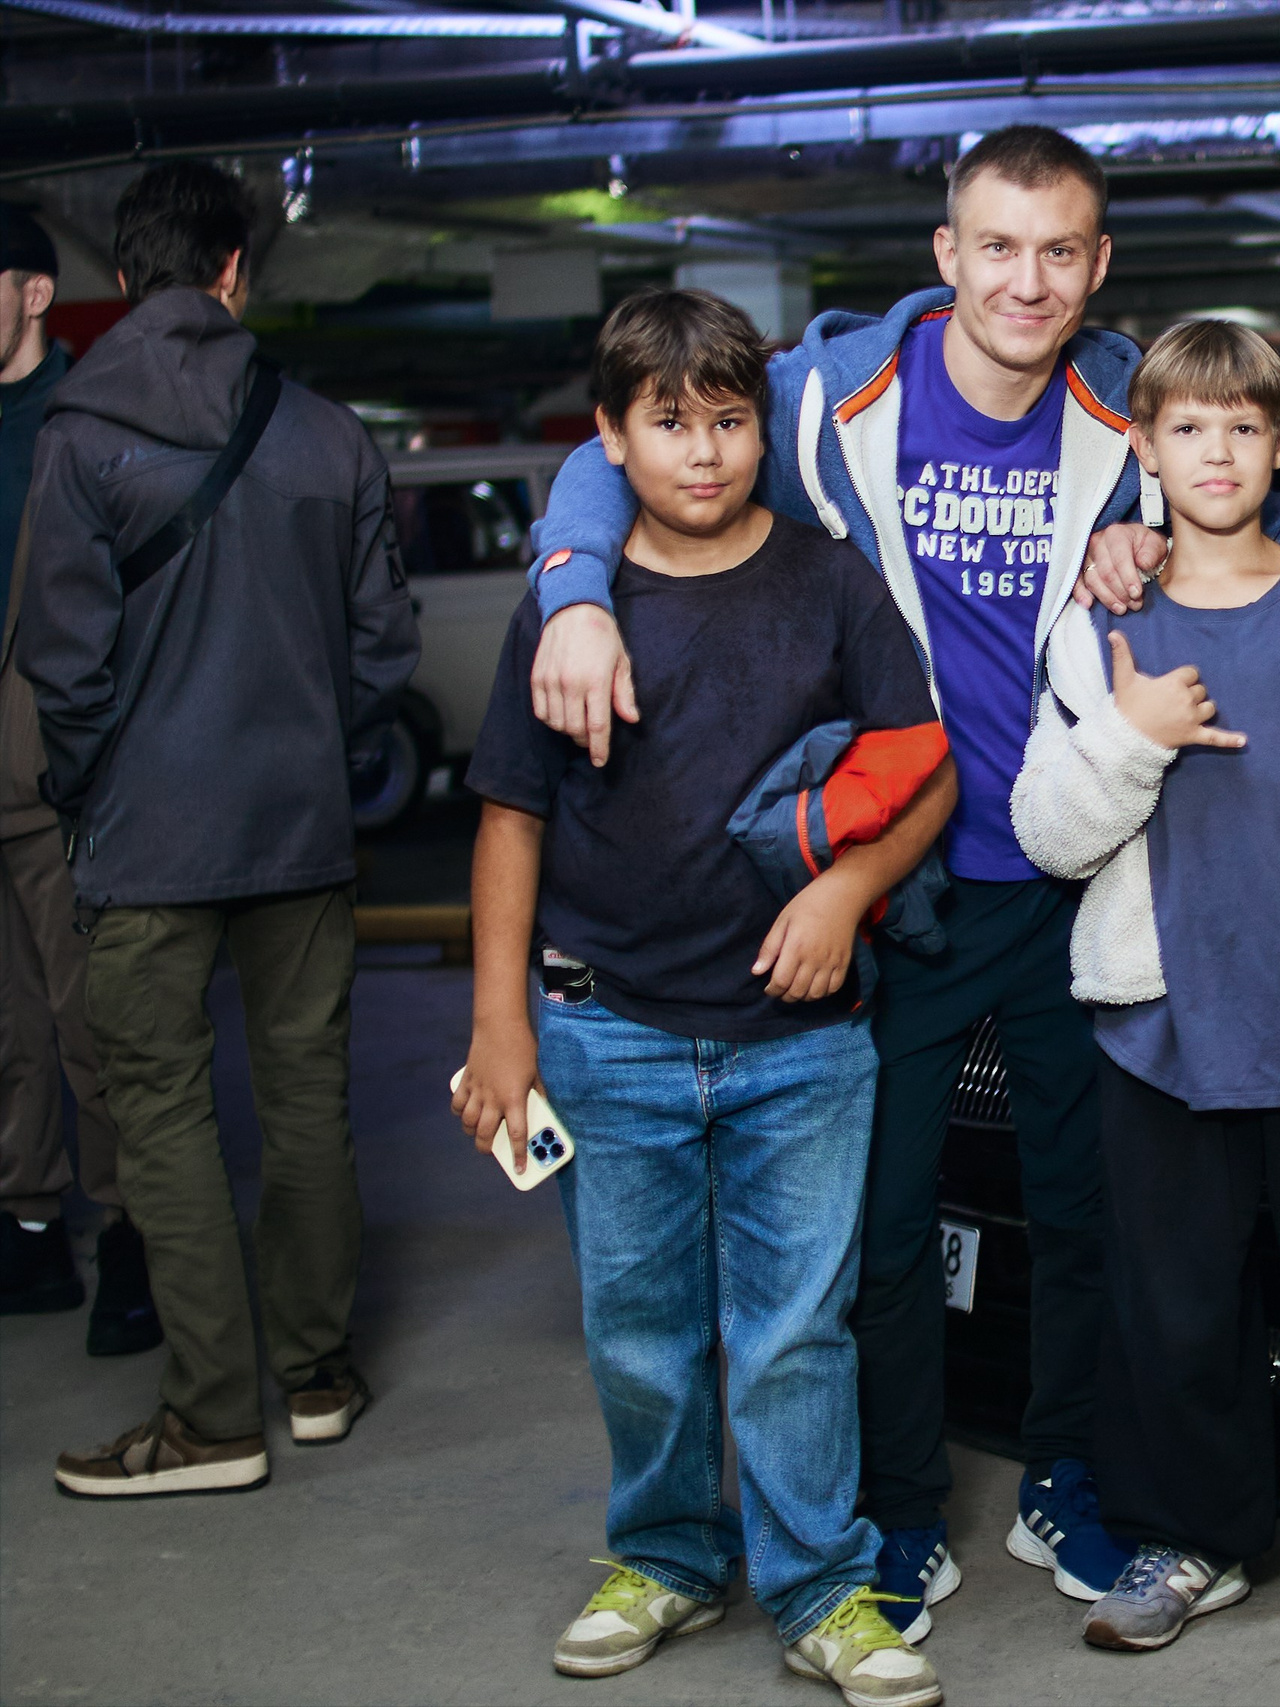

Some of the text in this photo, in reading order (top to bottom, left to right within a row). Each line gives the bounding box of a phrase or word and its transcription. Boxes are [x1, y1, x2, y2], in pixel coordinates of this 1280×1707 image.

[917, 531, 1051, 565] NEW YOR
[961, 568, 1035, 597] 1965
